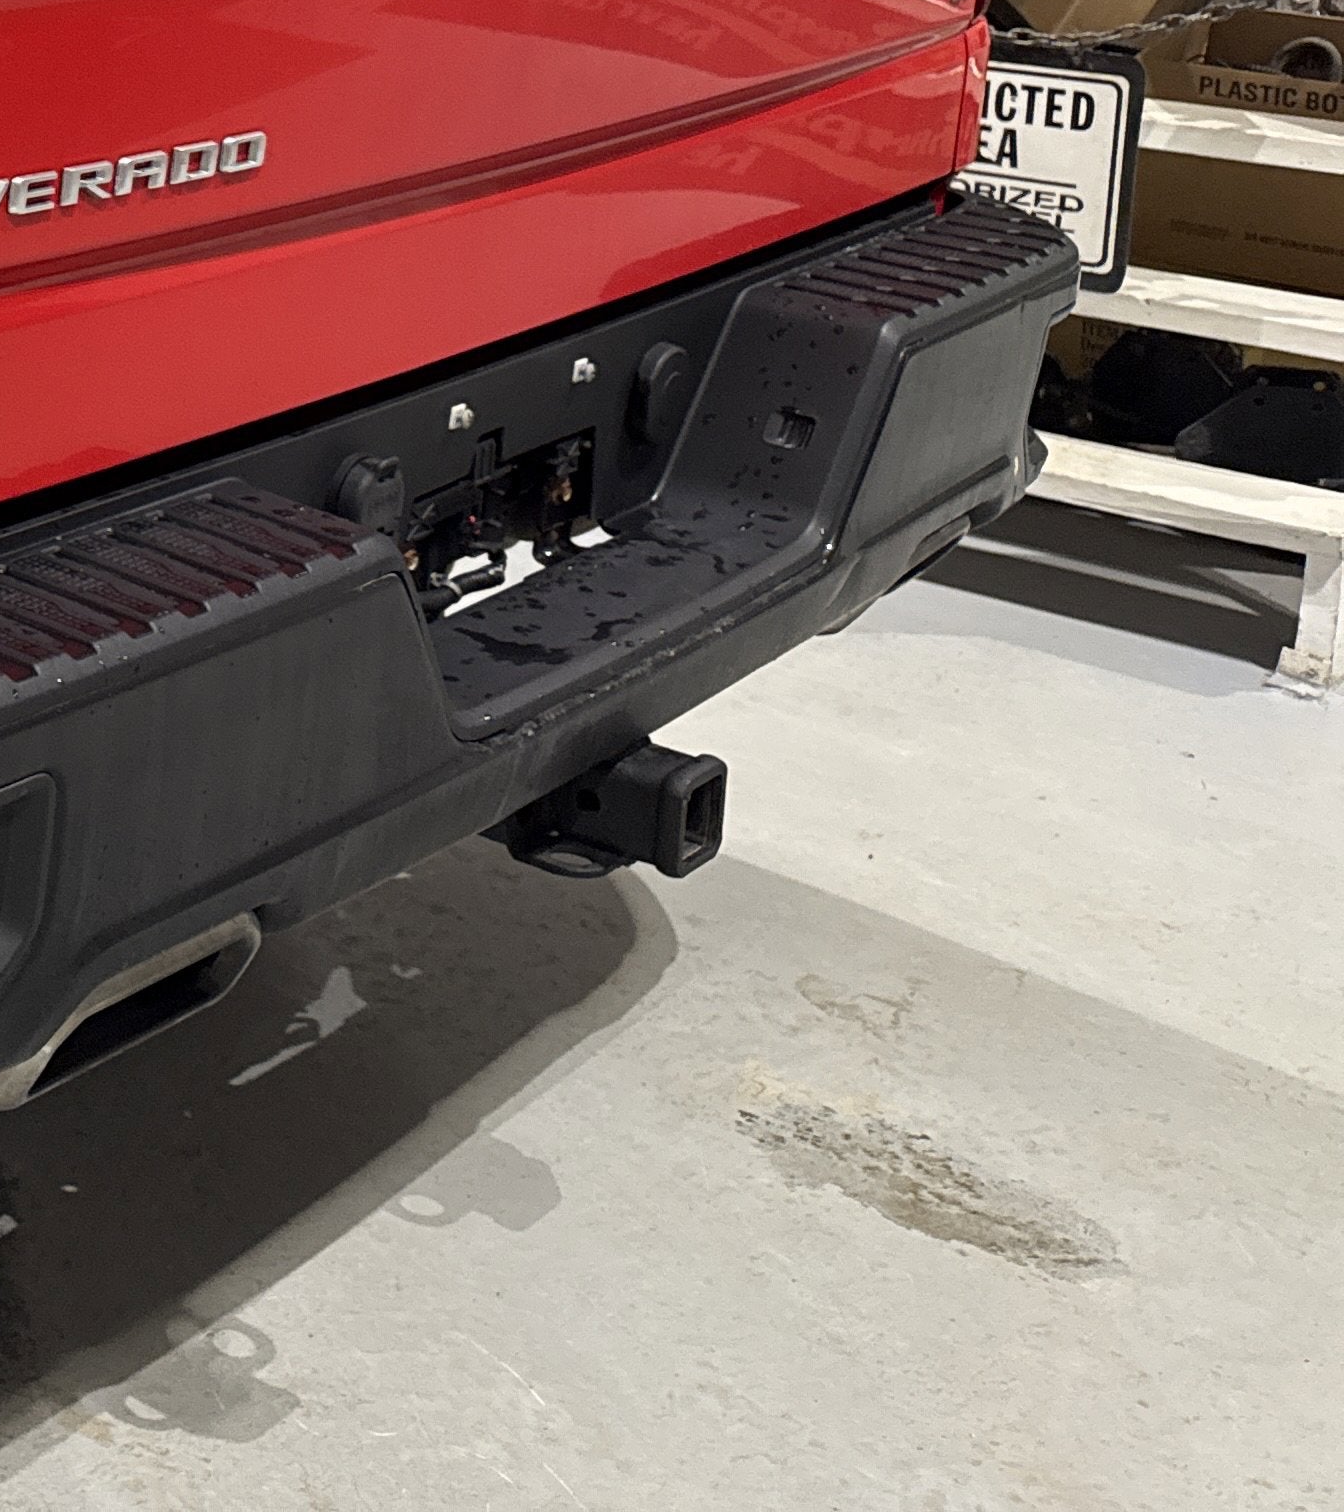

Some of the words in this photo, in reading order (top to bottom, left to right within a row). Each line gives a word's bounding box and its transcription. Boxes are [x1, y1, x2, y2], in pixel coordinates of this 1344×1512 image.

[981, 80, 1096, 131] ICTED
[1199, 76, 1298, 108] PLASTIC
[1305, 90, 1344, 115] BO
[976, 124, 1018, 169] EA
[950, 178, 1084, 213] RIZED
